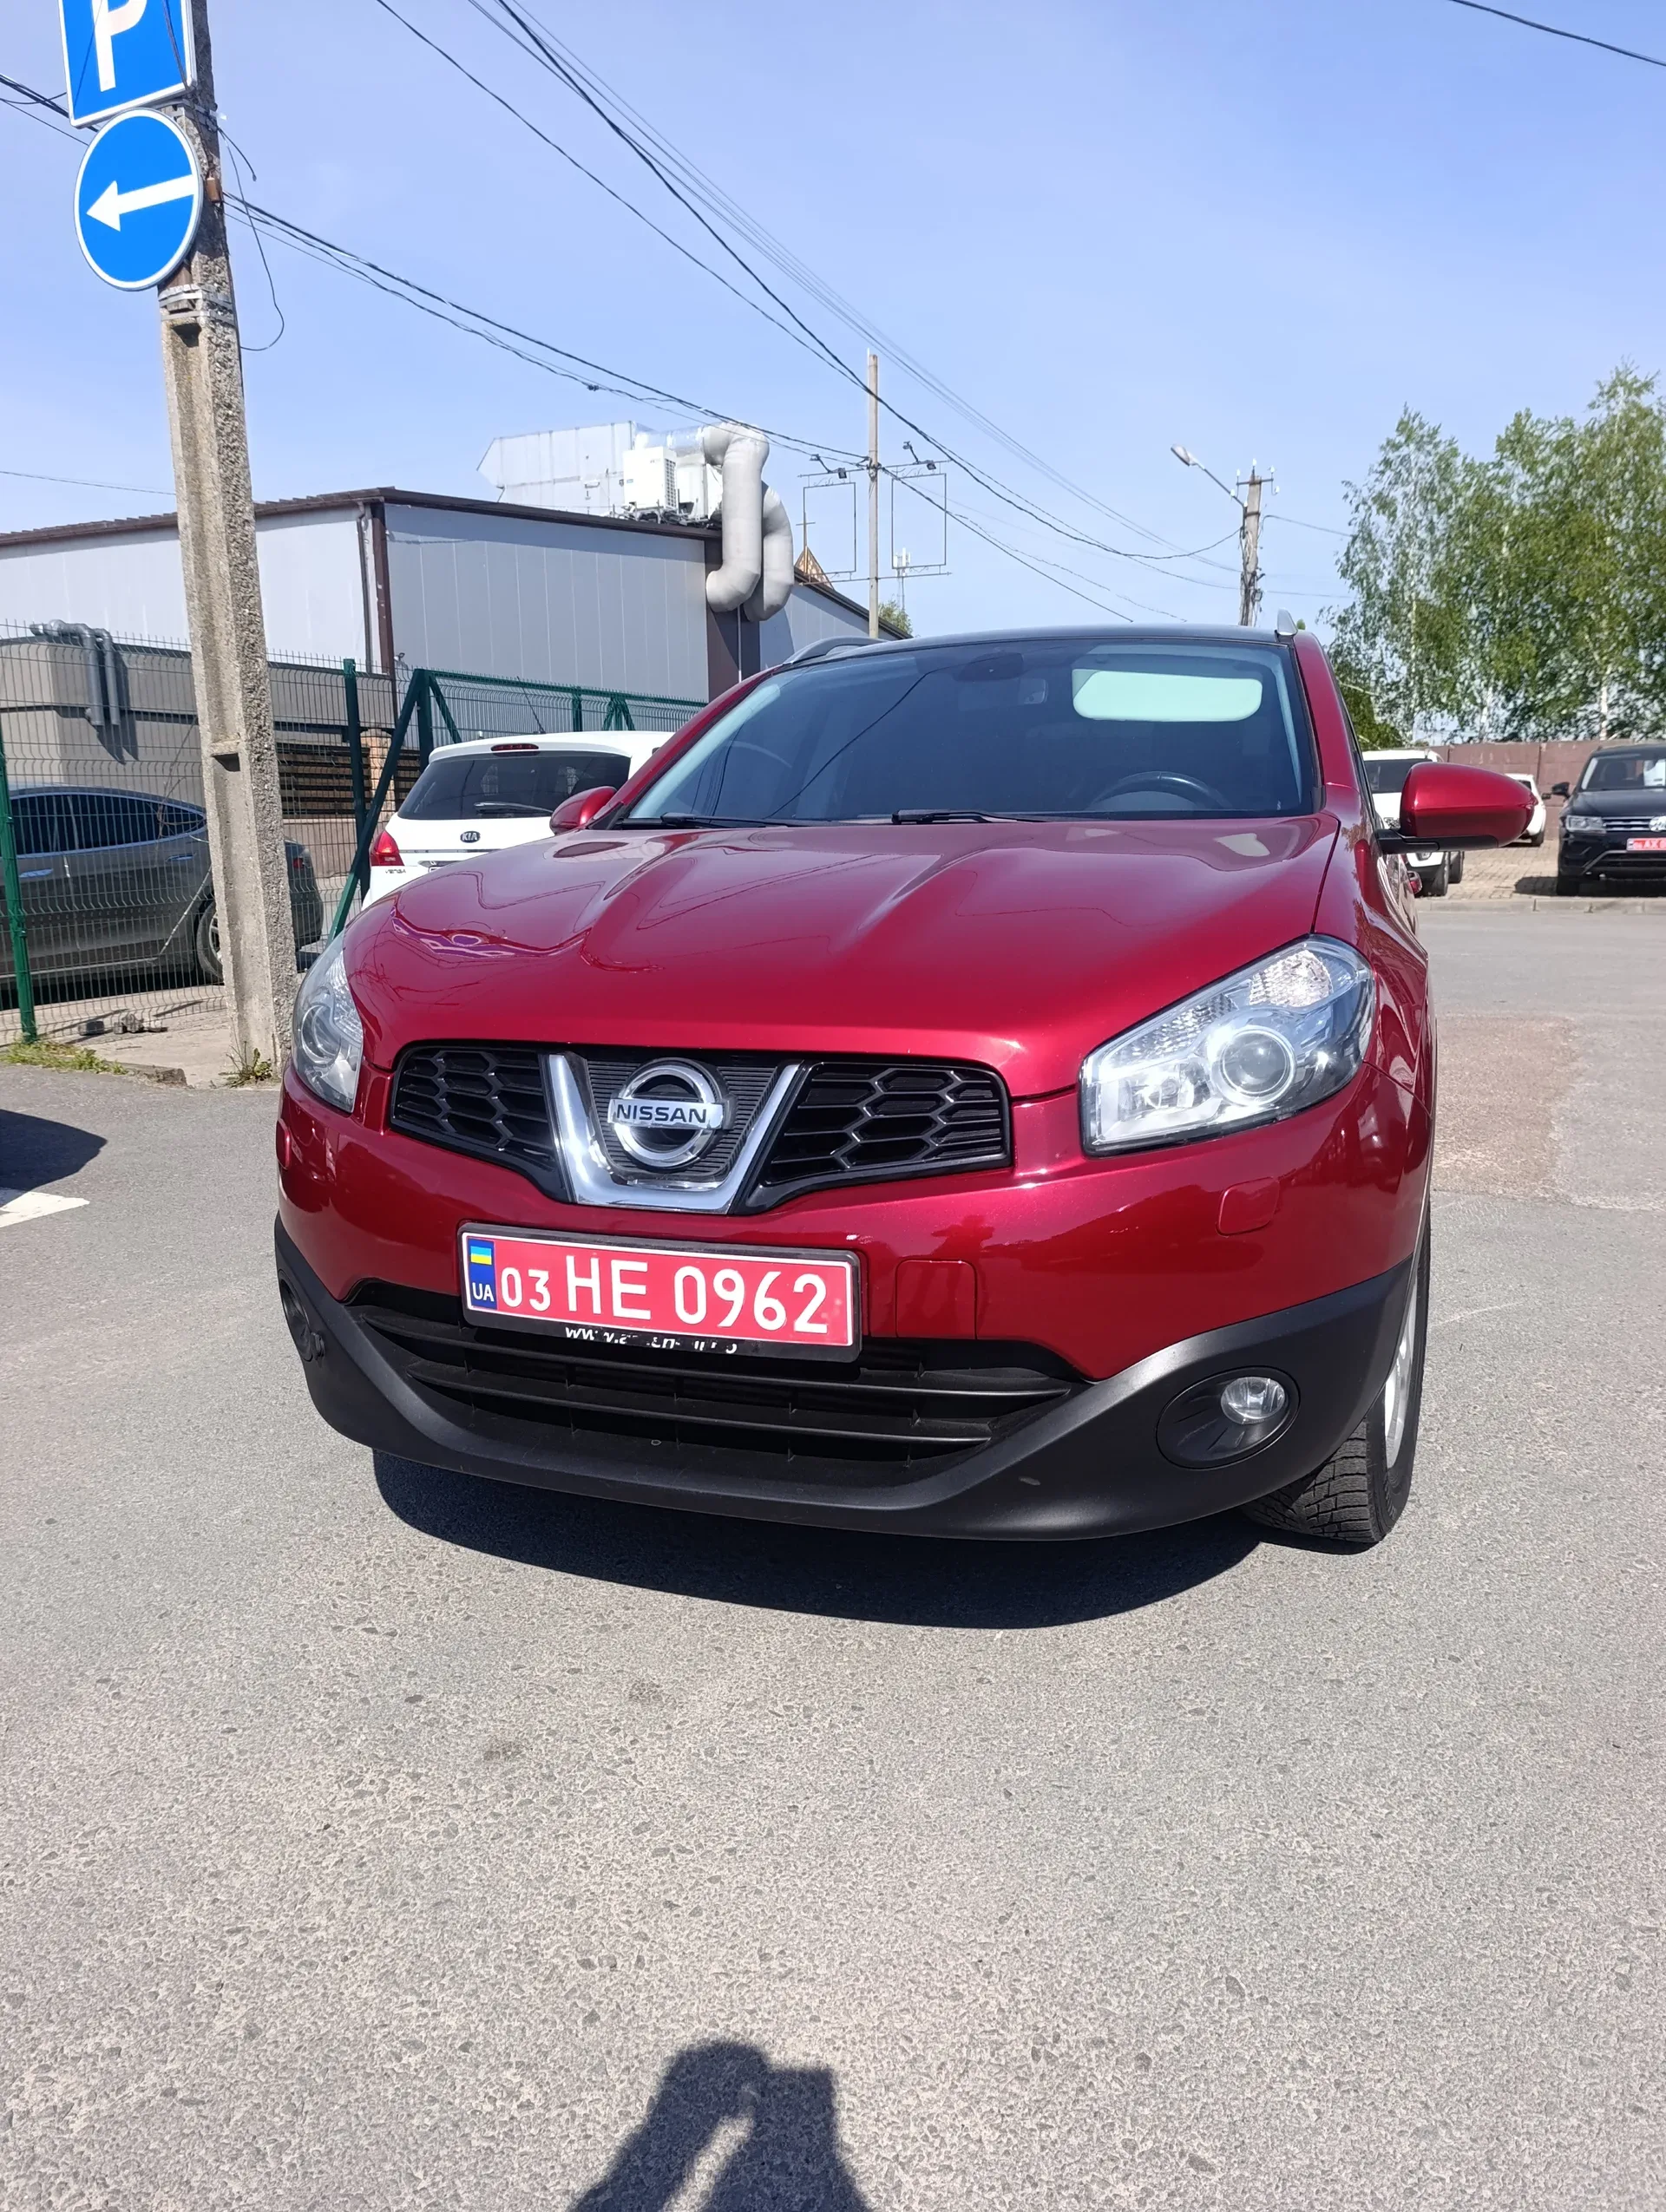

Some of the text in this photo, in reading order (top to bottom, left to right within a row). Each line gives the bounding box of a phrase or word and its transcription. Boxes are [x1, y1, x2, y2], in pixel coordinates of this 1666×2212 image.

[91, 0, 148, 92] P
[462, 832, 478, 841] KIA
[616, 1104, 707, 1123] NISSAN
[472, 1282, 495, 1302] UA
[501, 1255, 828, 1334] 03 HE 0962
